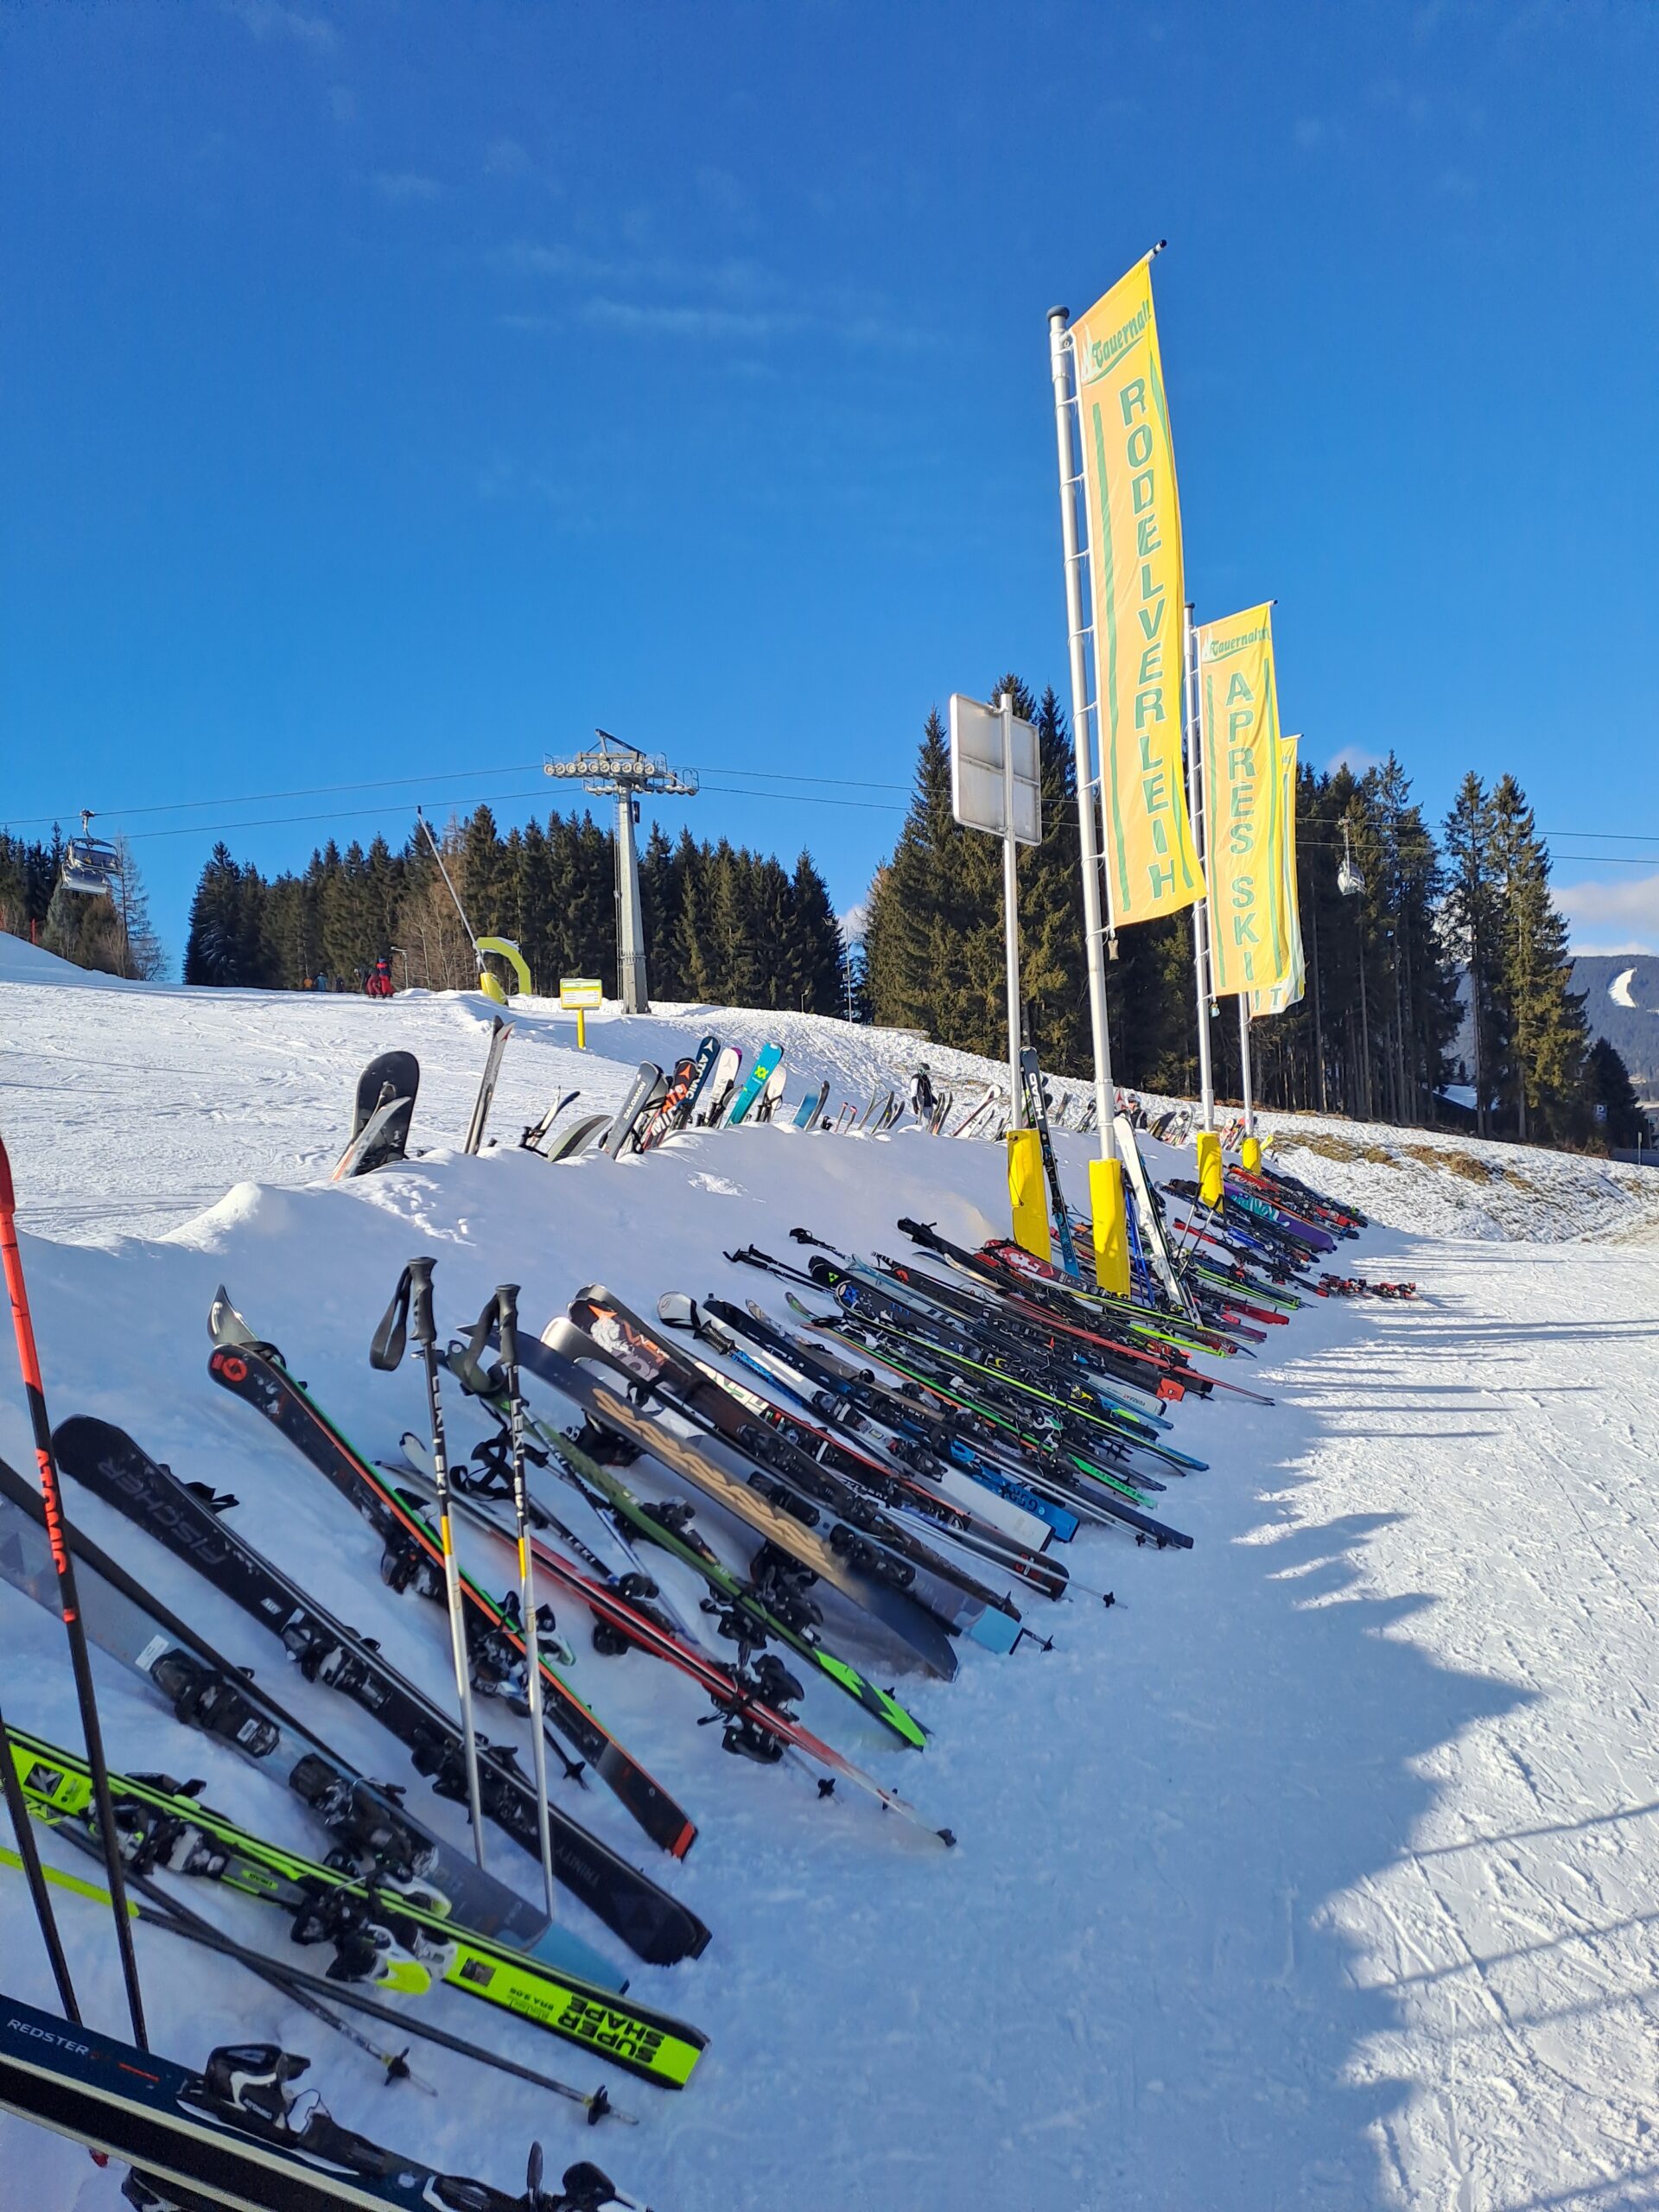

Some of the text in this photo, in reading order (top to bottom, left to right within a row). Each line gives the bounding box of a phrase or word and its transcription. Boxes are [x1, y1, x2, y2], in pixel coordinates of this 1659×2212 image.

[1092, 299, 1152, 368] Tauernal
[1119, 377, 1176, 899] RODELVERLEIH
[1231, 876, 1259, 982] SKI
[623, 1081, 646, 1120] SALOMON
[685, 1052, 709, 1100] ATOMIC
[1028, 1072, 1045, 1120] HEAD
[511, 1398, 525, 1454] LEKI
[35, 1448, 67, 1574] ATOMIC
[98, 1457, 227, 1565] FISCHER
[555, 1846, 601, 1888] TRINITY
[7, 2018, 90, 2056] REDSTER
[557, 2012, 658, 2063] SUPER
[567, 1994, 665, 2049] SHAPE
